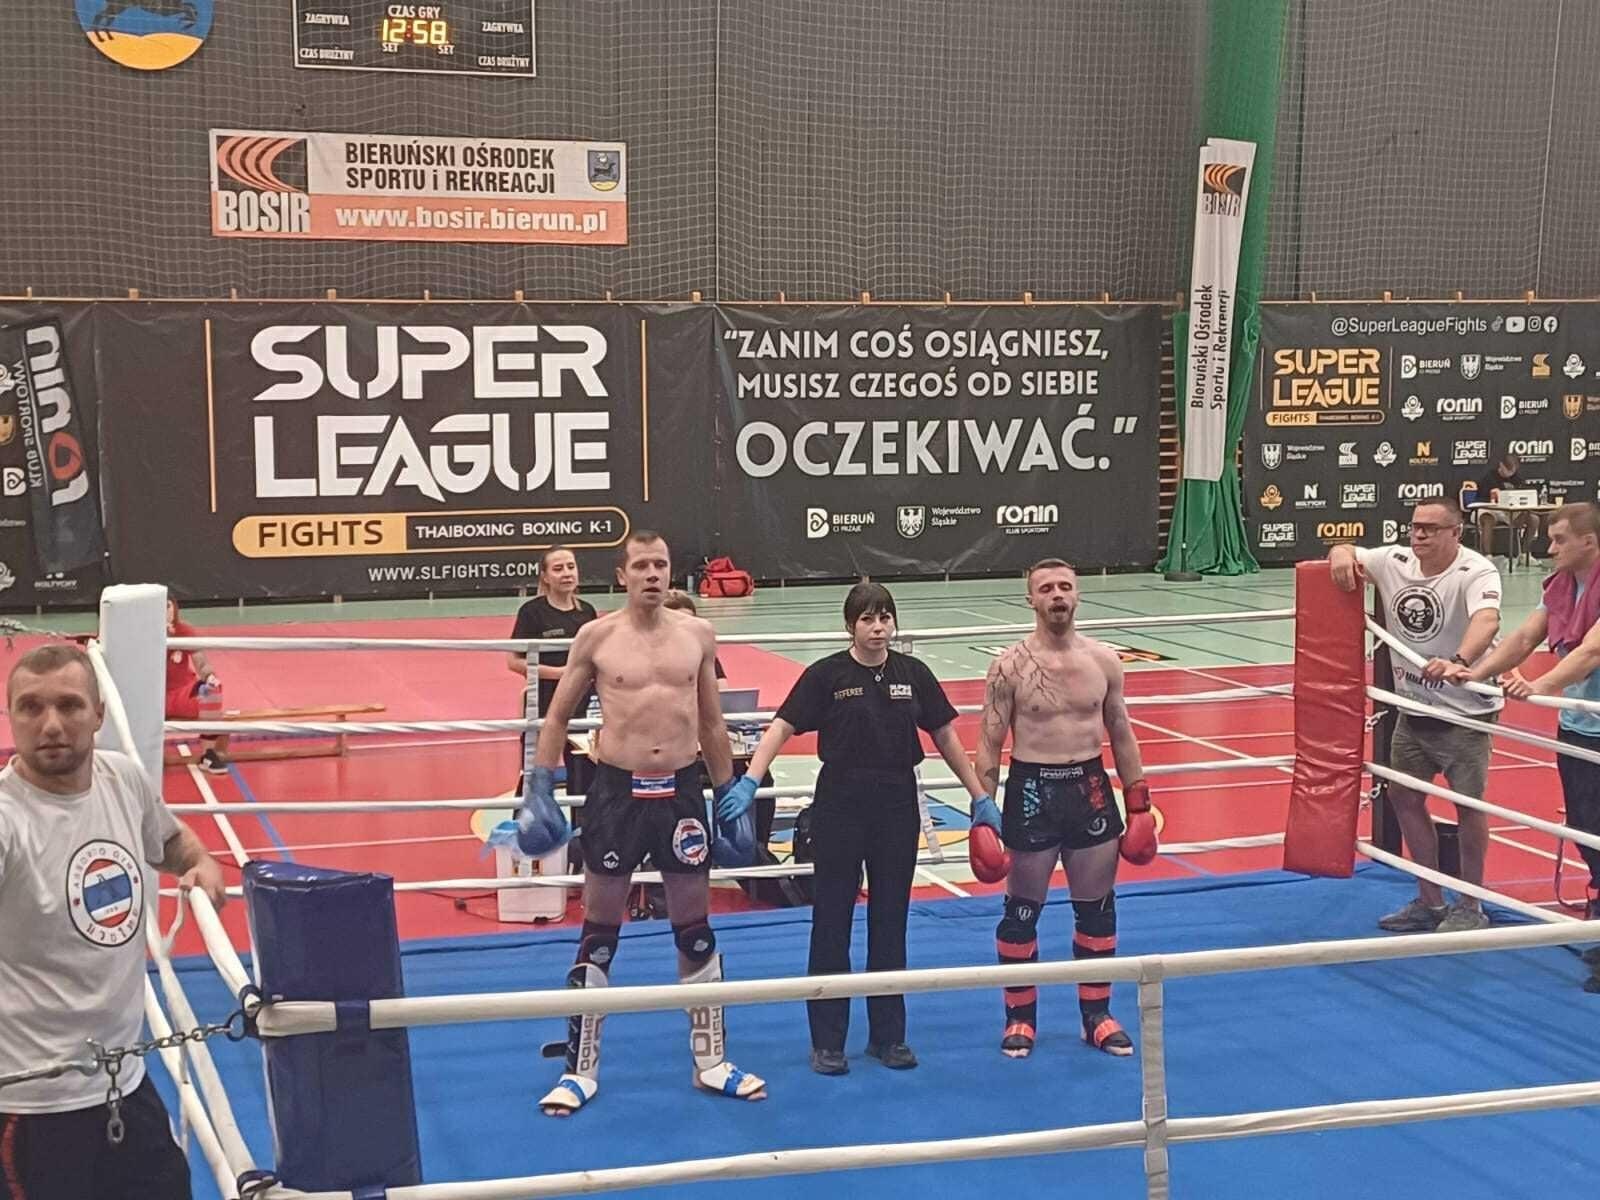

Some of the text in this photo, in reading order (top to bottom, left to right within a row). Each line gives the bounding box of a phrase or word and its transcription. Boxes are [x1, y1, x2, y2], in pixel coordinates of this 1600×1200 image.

[305, 13, 349, 26] ZAGRYWKA
[388, 5, 440, 19] CZAS GRY
[382, 19, 448, 45] 12:58
[482, 22, 524, 34] ZAGRYWKA
[300, 49, 318, 59] CZAS
[382, 43, 398, 53] SET
[438, 45, 455, 55] SET
[478, 56, 495, 66] CZAS
[345, 140, 554, 169] BIERUŃSKI OŚRODEK
[347, 167, 554, 193] SPORTU i REKREACJI
[218, 190, 310, 233] BOSIR
[1204, 192, 1241, 217] BOSIR
[336, 207, 607, 234] www.bosir.bierun.pl
[1193, 283, 1214, 341] Ośrodek
[1331, 316, 1487, 336] @SuperLeagueFights
[723, 324, 1109, 366] “ZANIM COŚ OSIĄGNIESZ,
[250, 325, 609, 400] SUPER
[1274, 349, 1381, 375] SUPER
[1419, 358, 1451, 369] BIERUŃ
[737, 366, 1099, 399] MUSISZ CZEGOŚ OD SIEBIE
[1210, 366, 1226, 410] Sportu
[1273, 378, 1380, 408] LEAGUE
[1436, 397, 1483, 412] ronin
[1273, 413, 1310, 423] FIGHTS
[1455, 441, 1487, 450] SUPER
[1508, 440, 1554, 454] ronin
[253, 411, 611, 502] LEAGUE
[1455, 449, 1487, 458] LEAGUE
[1343, 484, 1376, 493] SUPER
[1398, 483, 1444, 498] ronin
[832, 511, 875, 525] BIERUŃ
[931, 505, 981, 517] Województwo
[996, 504, 1059, 525] ronin
[258, 519, 384, 548] FIGHTS
[415, 520, 612, 539] THAIBOXING BOXING K-1
[1262, 523, 1294, 533] SUPER
[1317, 522, 1364, 537] ronin
[1262, 532, 1295, 541] LEAGUE
[368, 563, 540, 582] WWW.SLFIGHTS.COM
